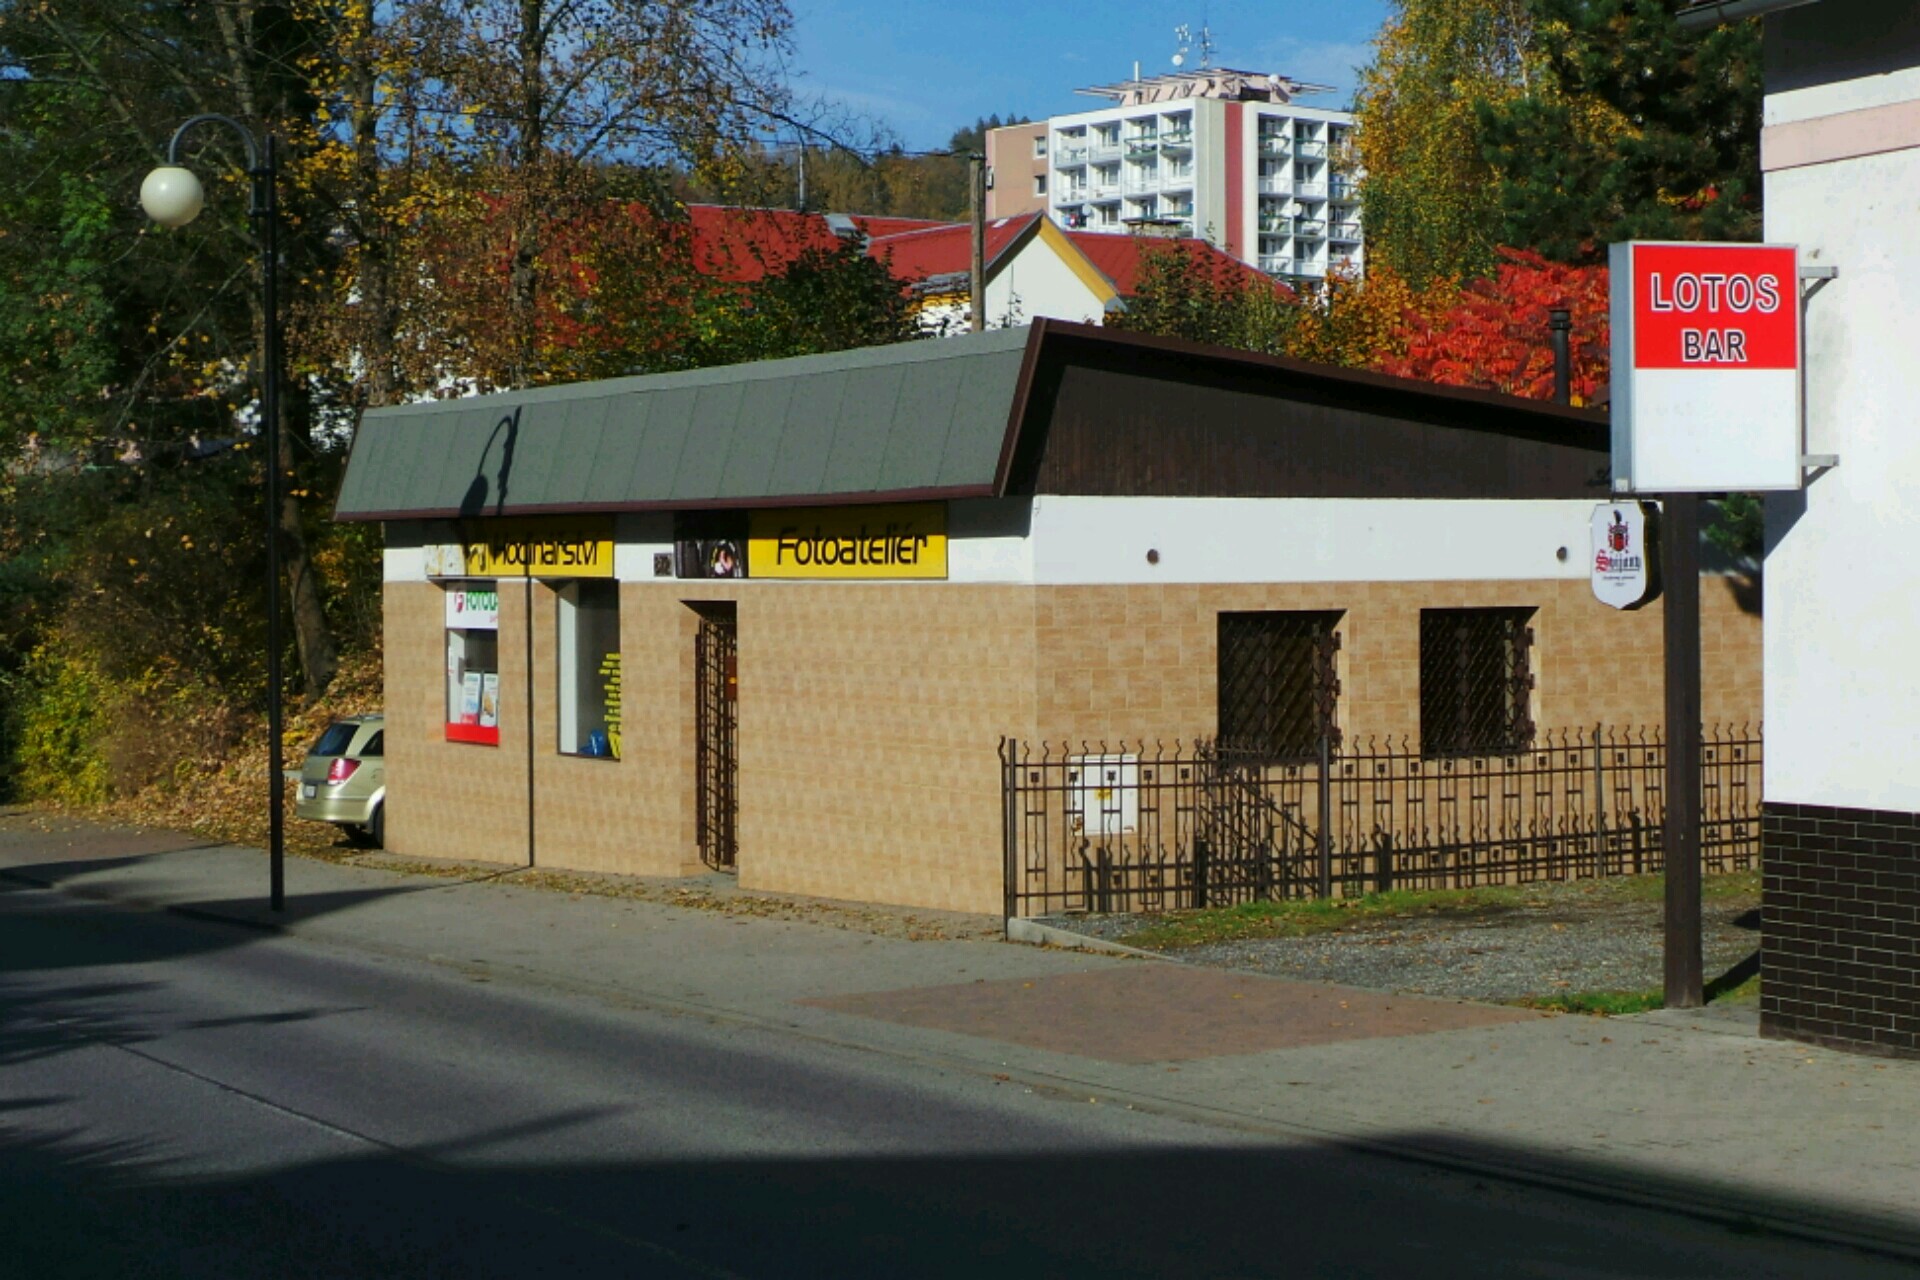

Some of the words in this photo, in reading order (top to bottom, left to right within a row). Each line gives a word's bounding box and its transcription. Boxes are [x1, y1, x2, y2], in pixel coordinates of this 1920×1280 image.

[1650, 272, 1780, 314] LOTOS
[1681, 328, 1748, 362] BAR
[777, 522, 928, 566] Fotoateliér
